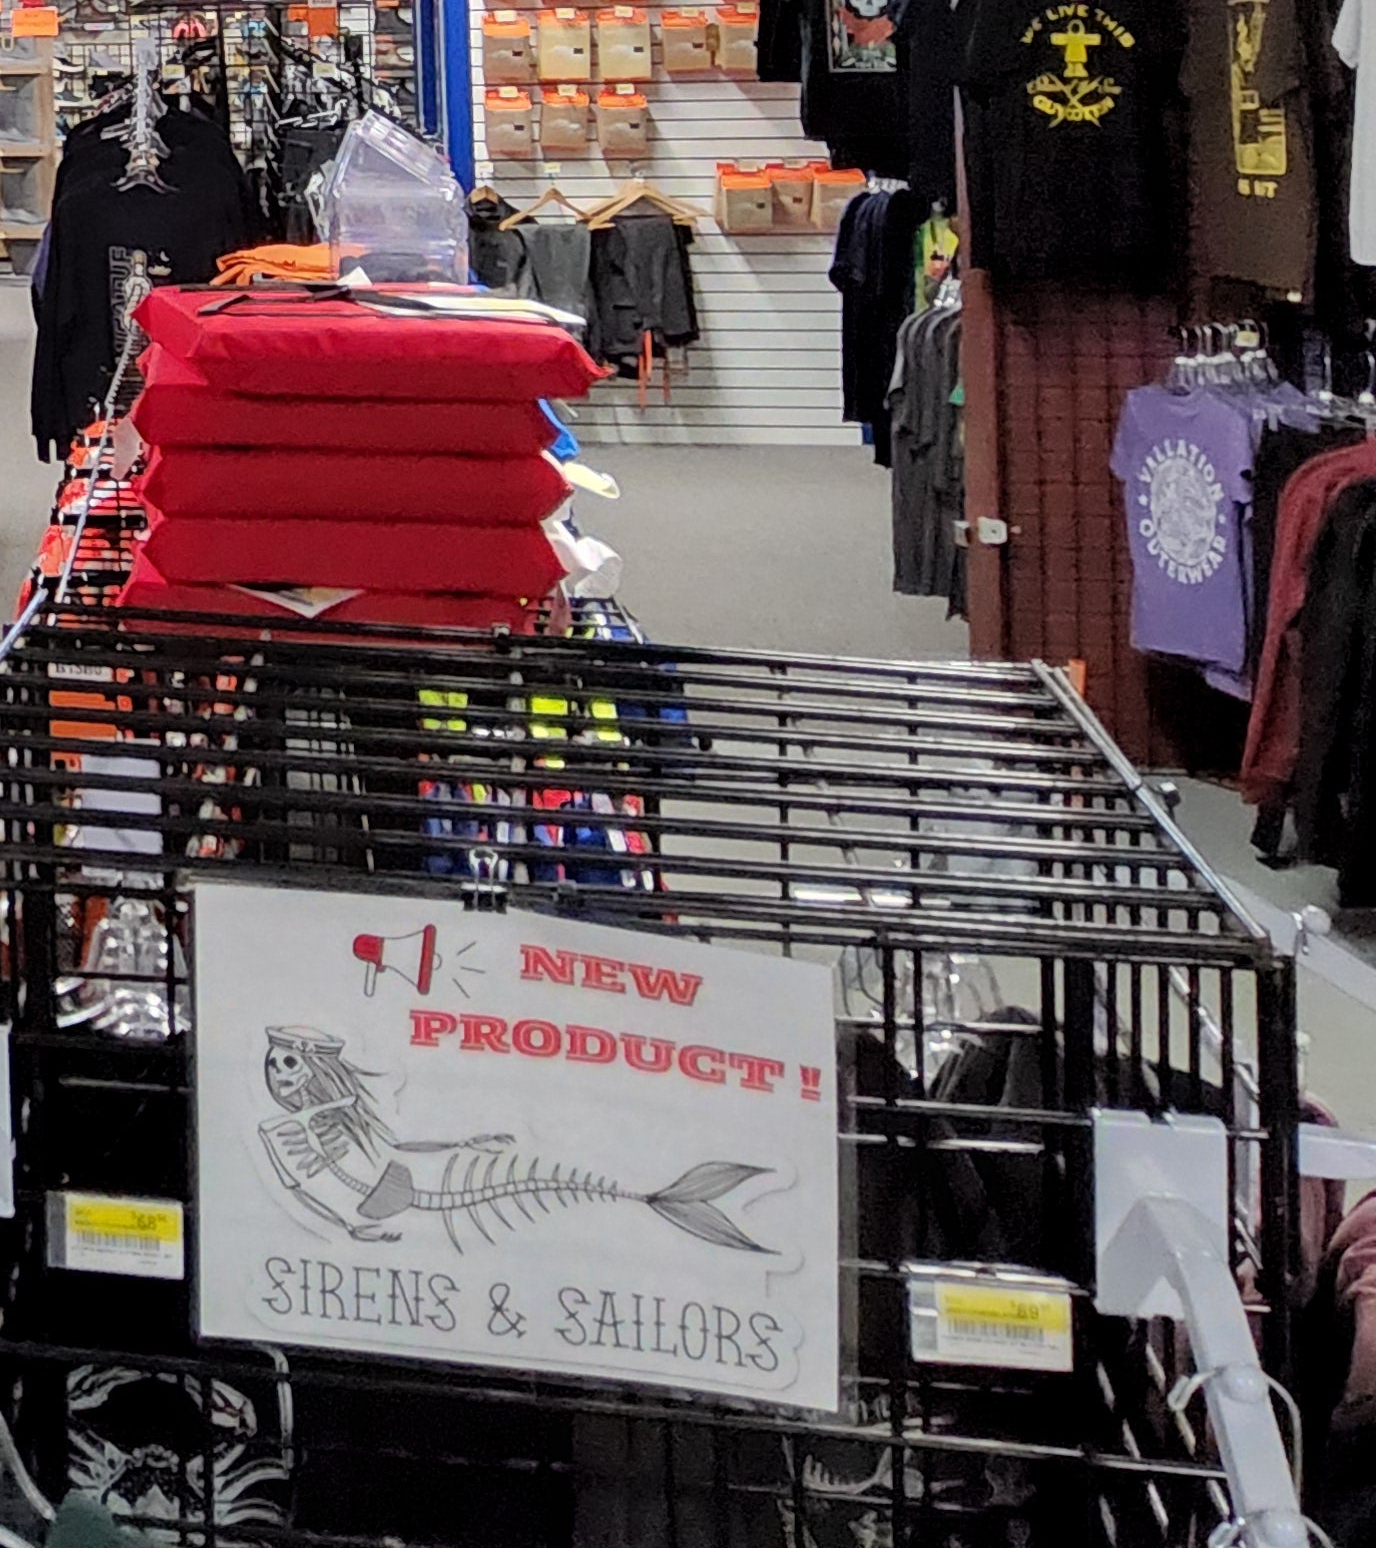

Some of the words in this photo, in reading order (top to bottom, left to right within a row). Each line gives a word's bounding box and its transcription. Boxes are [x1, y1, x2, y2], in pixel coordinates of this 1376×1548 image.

[1045, 4, 1090, 21] LIVE
[1138, 438, 1225, 502] VALLATION
[1139, 518, 1227, 584] OUTERWEAR
[519, 944, 703, 1008] NEW
[262, 1257, 461, 1332] SIRENS
[487, 1282, 527, 1340] &
[554, 1286, 784, 1373] SAILORS
